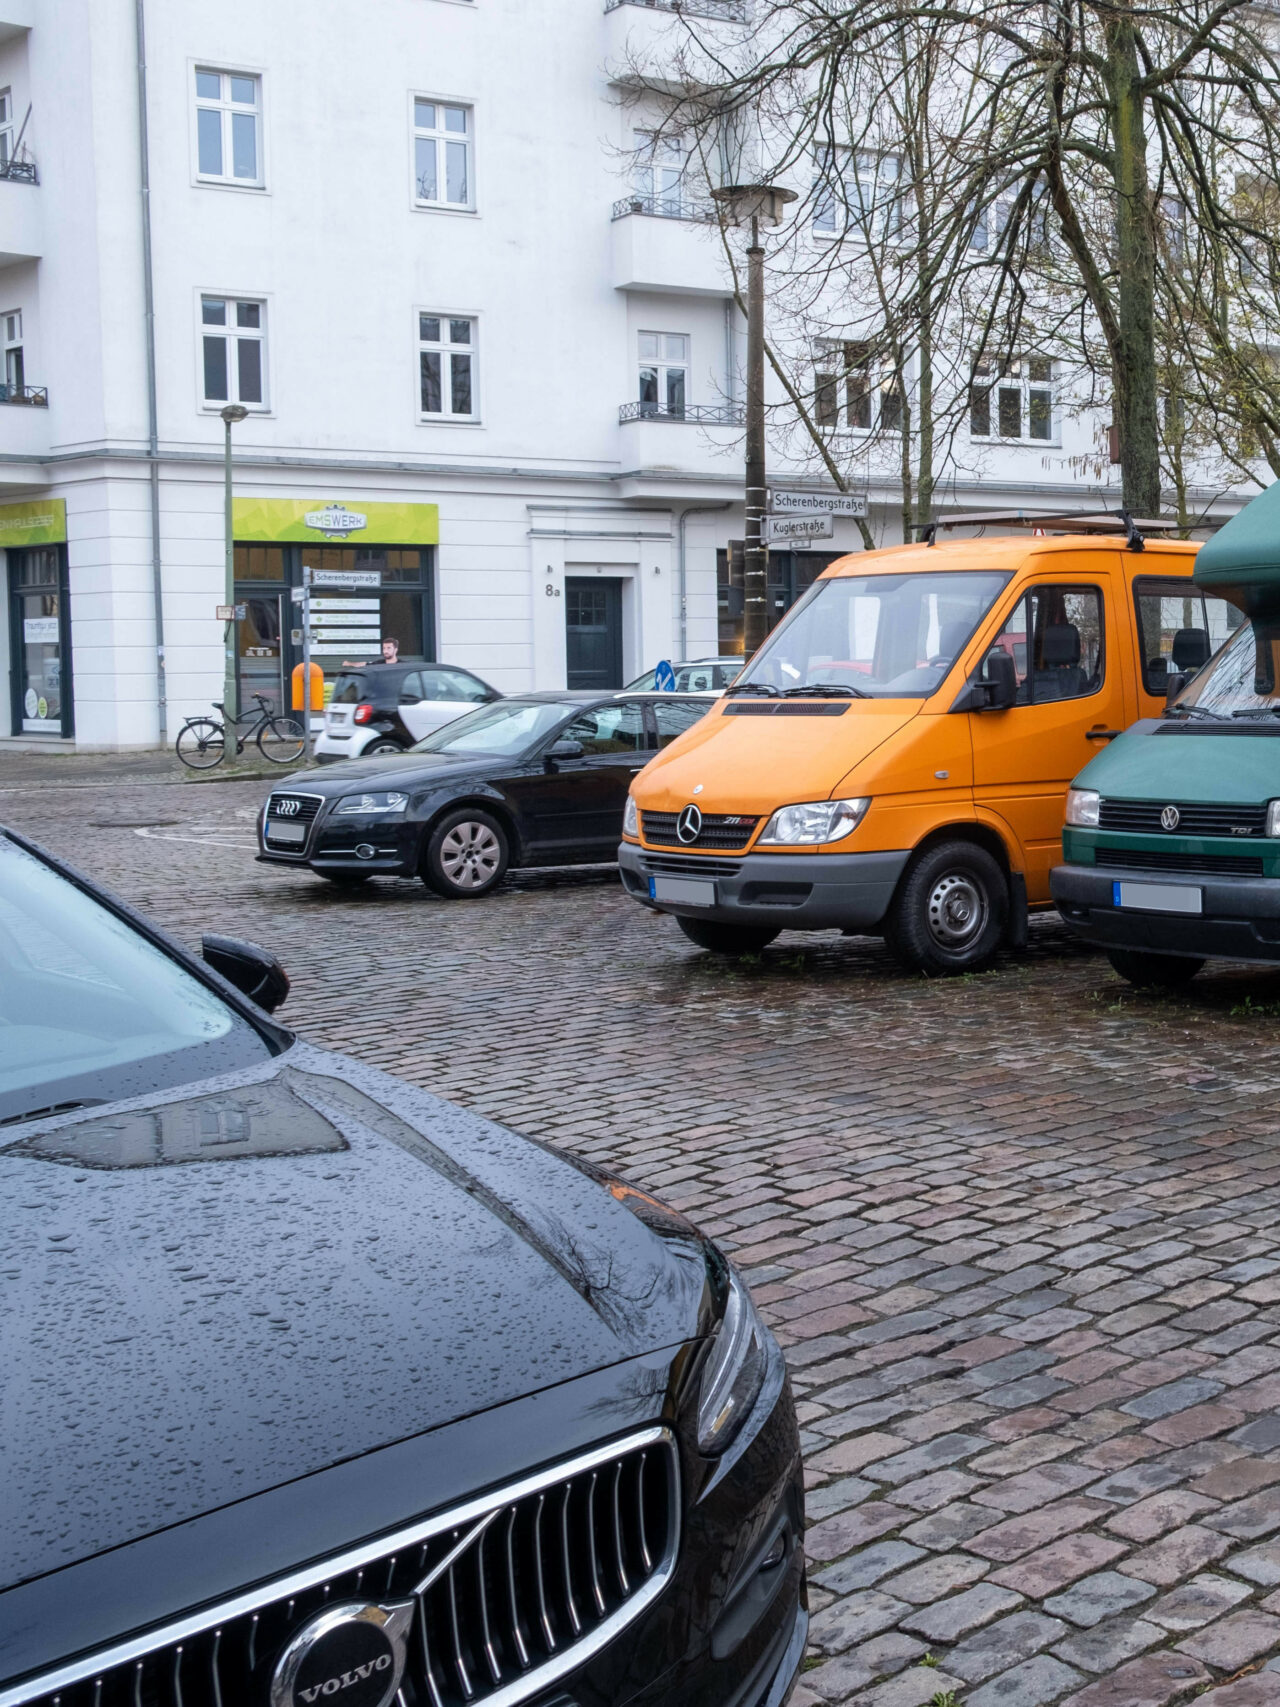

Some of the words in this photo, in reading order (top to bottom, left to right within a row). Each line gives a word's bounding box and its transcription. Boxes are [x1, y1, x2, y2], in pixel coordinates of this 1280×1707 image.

[775, 493, 864, 514] Scherenbergstraße
[308, 513, 363, 528] EMSWERK
[773, 520, 825, 538] Kuglerstraße
[316, 572, 378, 584] Scherenbergstraße
[545, 584, 560, 597] 8a
[298, 1654, 392, 1703] VOLVO
